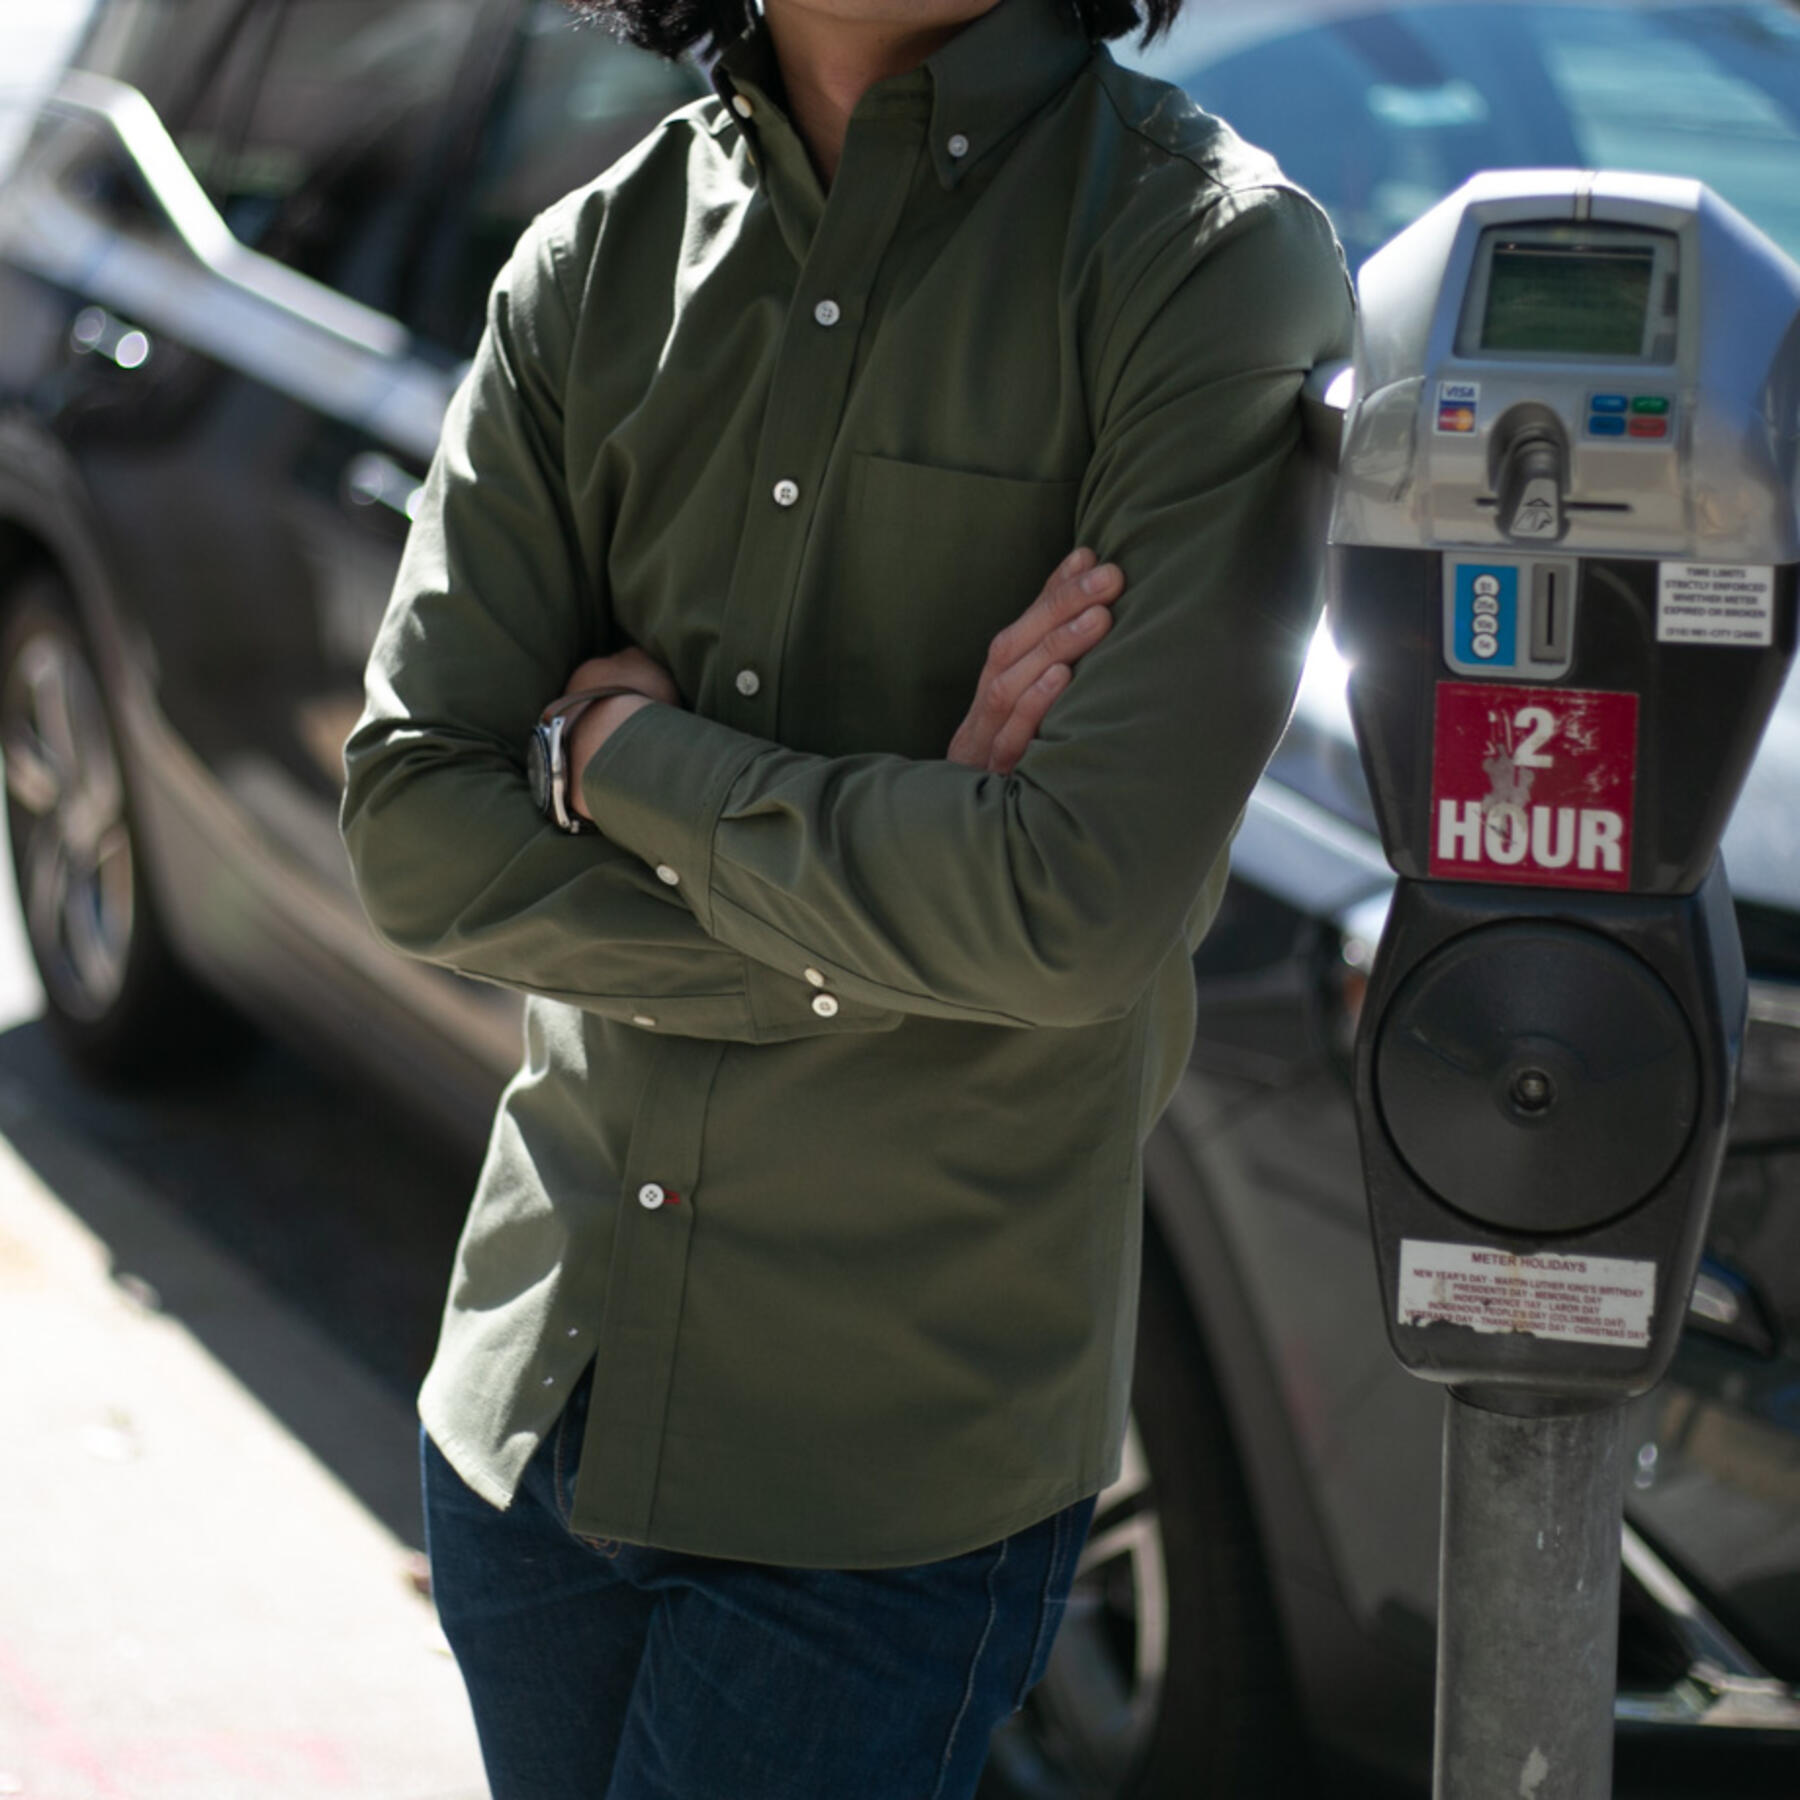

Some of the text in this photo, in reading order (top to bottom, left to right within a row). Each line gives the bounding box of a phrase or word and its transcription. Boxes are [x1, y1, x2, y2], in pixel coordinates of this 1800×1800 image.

[1446, 386, 1475, 398] VISA
[1686, 567, 1746, 578] TIME LIMITS
[1664, 580, 1767, 593] STRICTLY ENFORCED
[1673, 593, 1757, 605] WHETHER METER
[1664, 606, 1766, 618] EXPIRED OR BROKEN
[1513, 706, 1556, 768] 2
[1437, 799, 1624, 872] HOUR
[1472, 1252, 1587, 1273] METER HOLIDAYS
[1413, 1269, 1644, 1298] NEW YEAR'S DAY MARTIN LUTHER KING'S BIRTHDAY
[1453, 1283, 1602, 1304] PRESIDENTS DAY MEMORIAL DAY
[1428, 1301, 1481, 1313] INDIGENOUS
[1529, 1310, 1546, 1319] DAY
[1548, 1313, 1602, 1325] (COLUMBUS
[1604, 1317, 1626, 1328] DAY)
[1453, 1294, 1600, 1315] INDEPENDENCE DAY LABOR DAY
[1455, 1313, 1473, 1323] DAY
[1481, 1316, 1546, 1330] THANKSGIVING
[1548, 1322, 1566, 1332] DAY
[1574, 1324, 1625, 1338] CHRISTMAS
[1627, 1329, 1646, 1340] DAY
